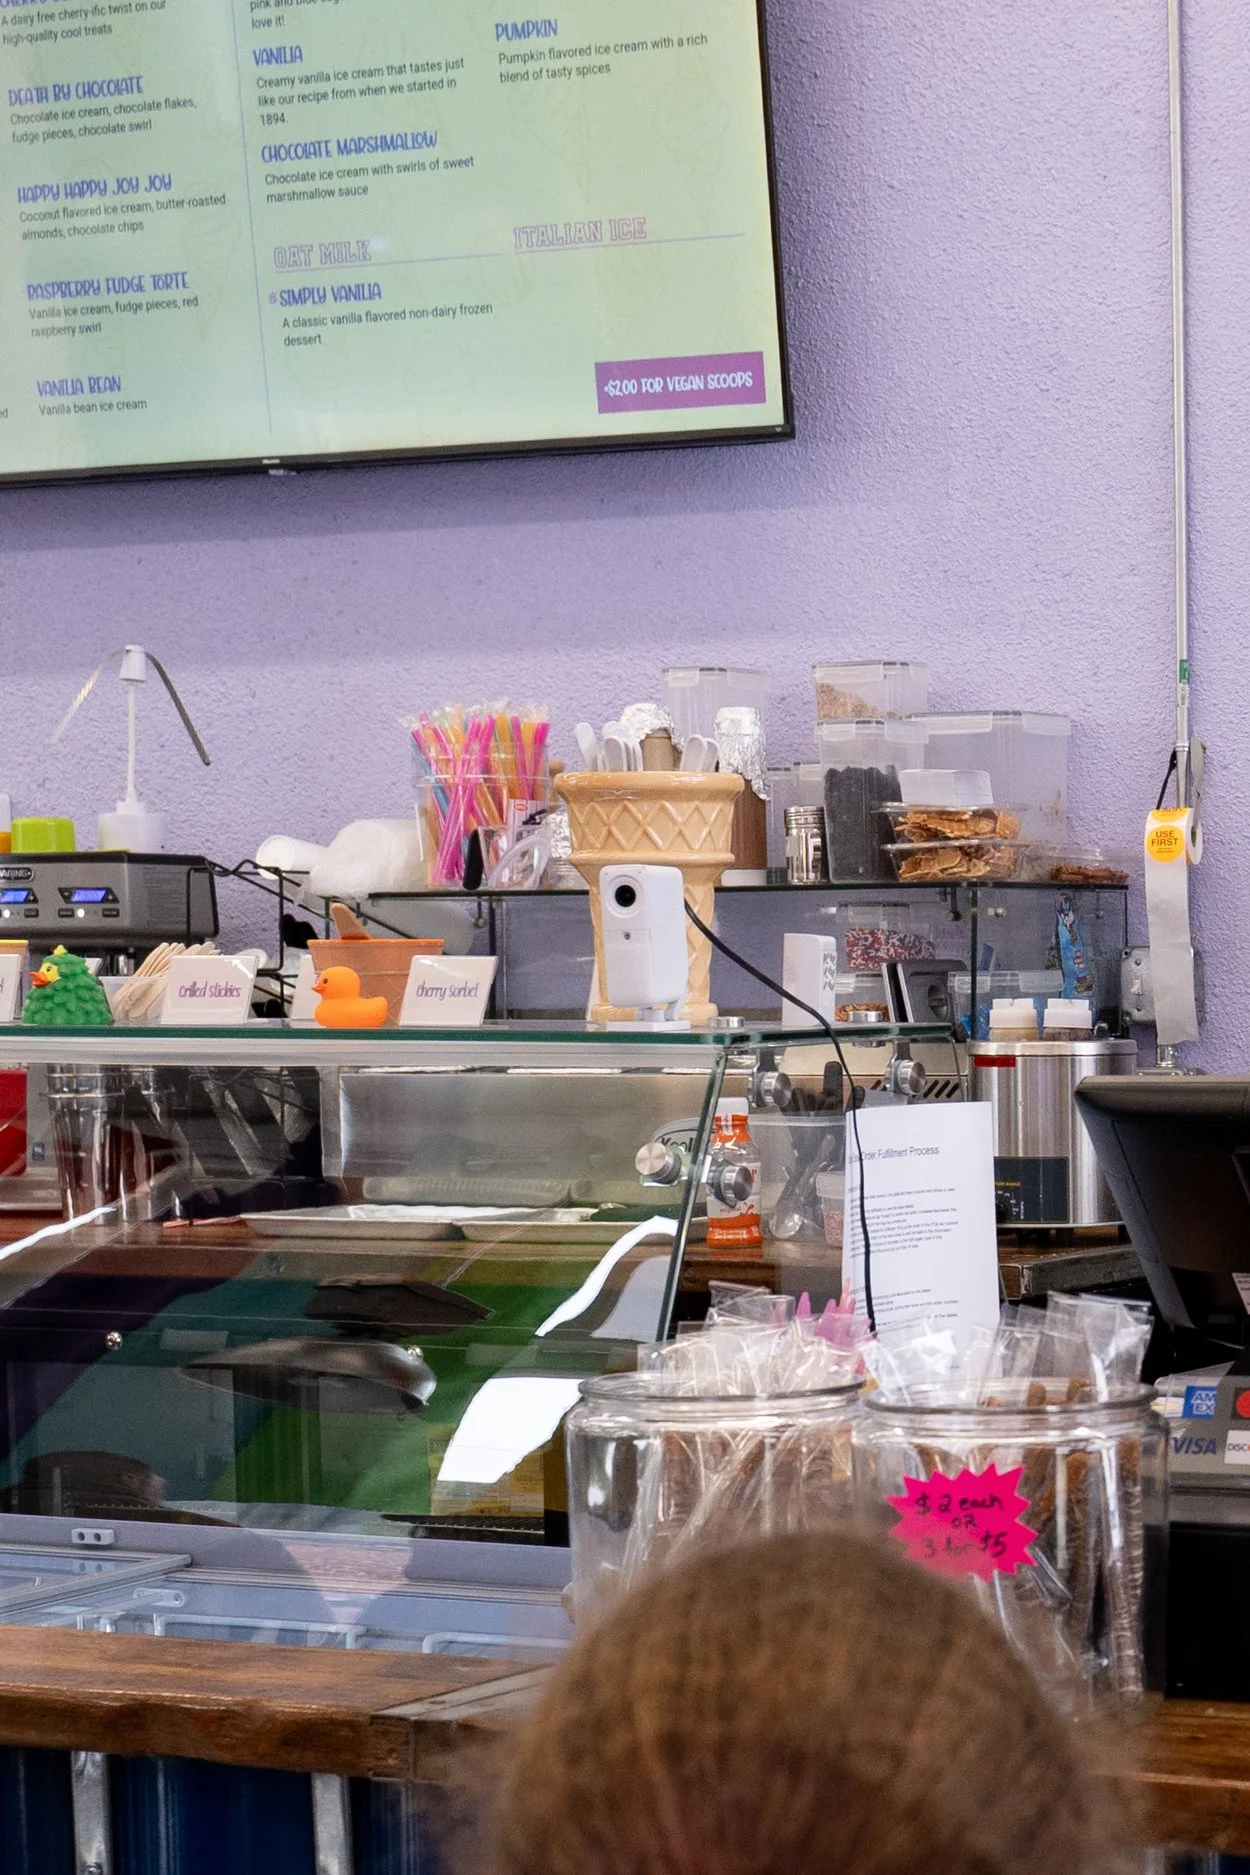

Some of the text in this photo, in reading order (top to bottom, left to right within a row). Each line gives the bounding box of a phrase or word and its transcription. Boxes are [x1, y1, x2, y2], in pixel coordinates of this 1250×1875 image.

[251, 18, 273, 29] love
[494, 19, 558, 41] PUMPKIN
[252, 46, 304, 66] VANILLA
[497, 33, 708, 66] Pumpkin flavored ice cream with a rich
[7, 76, 143, 107] DEATH BY CHOCOLATE
[9, 99, 196, 125] Chocolate ice cream, chocolate flakes,
[260, 113, 289, 126] 1894.
[260, 130, 438, 163] CHOCOLATE MARSHMALLOW
[16, 172, 172, 204] HAPPY HAPPY JOY JOY
[265, 187, 369, 203] marshmallow sauce
[18, 195, 227, 223] Coconut flavored ice cream, butter-roasted
[513, 217, 648, 249] ITALIAN ICE
[272, 239, 372, 268] OAT MILK
[26, 271, 188, 300] RASPBERRY FUDGE TORTE
[279, 282, 382, 307] SIMPLY VANILLA
[283, 333, 322, 346] dessert
[36, 375, 122, 397] VANILLA BEAN
[639, 375, 665, 394] FOR
[665, 373, 705, 392] VEGAN
[706, 370, 754, 390] SCOOPS
[37, 401, 147, 415] Vanilla bean ice cream
[1151, 838, 1180, 847] FIRST
[1155, 830, 1175, 839] USE
[909, 1145, 939, 1156] Process
[1171, 1437, 1218, 1455] VISA
[959, 1492, 1003, 1511] each
[980, 1530, 1008, 1558] $5
